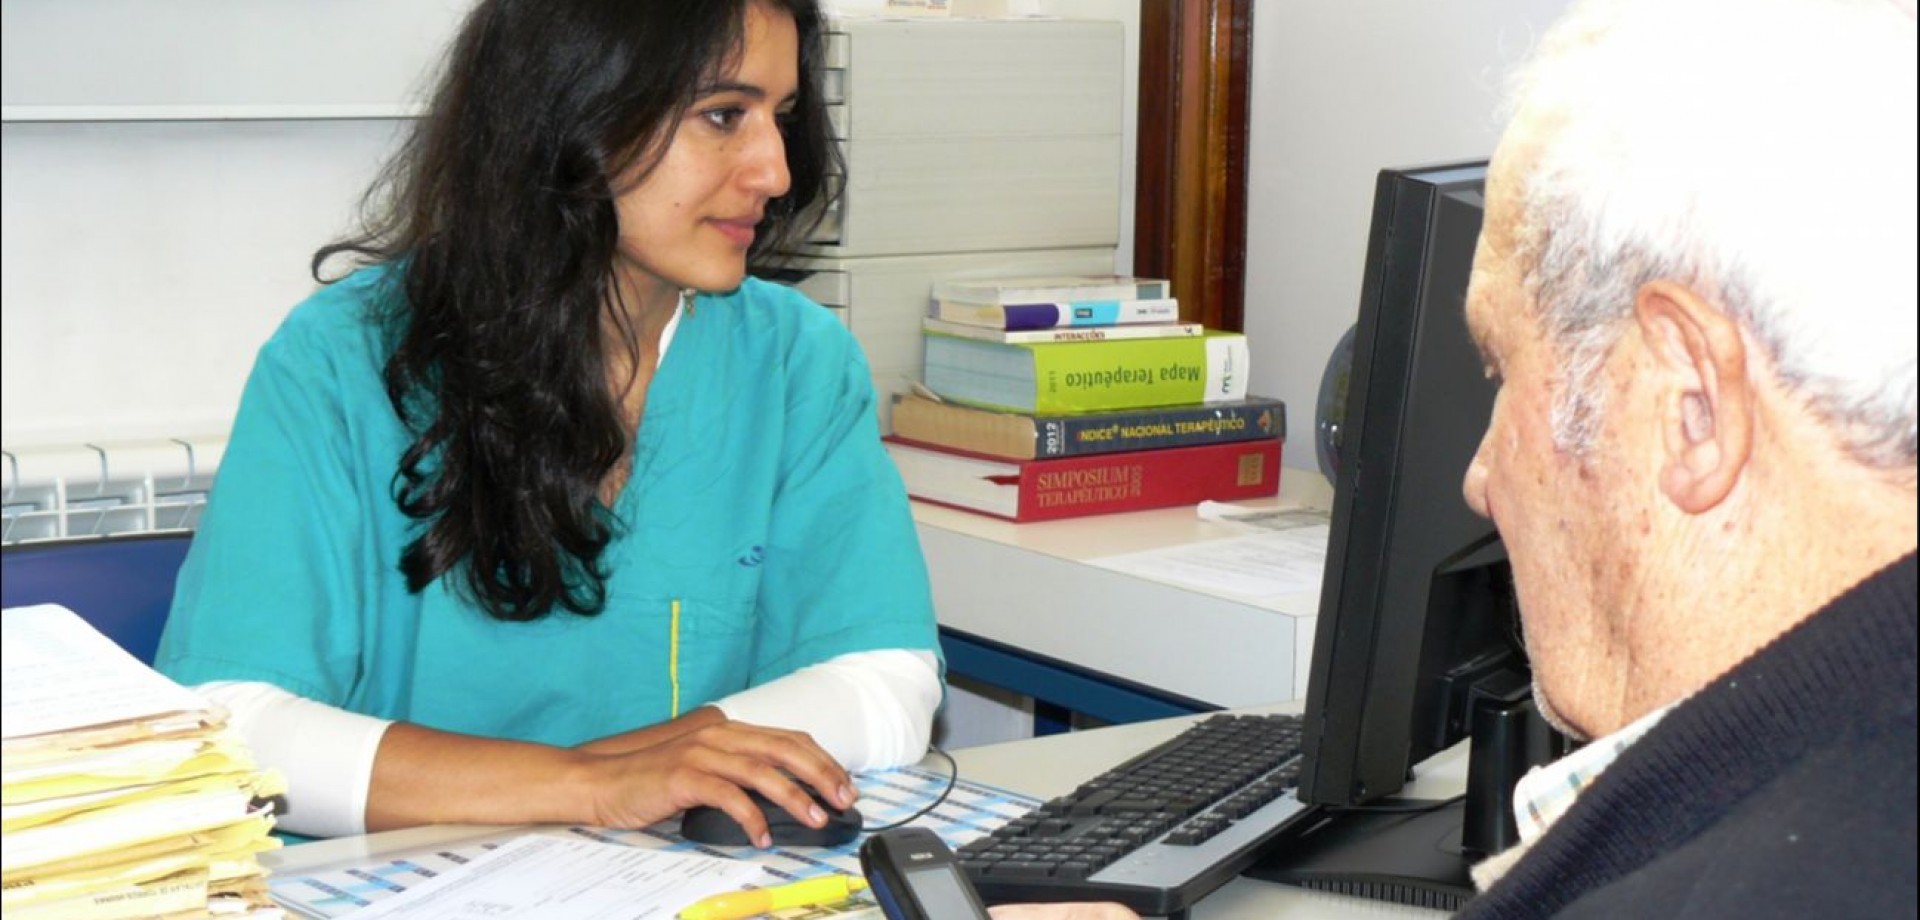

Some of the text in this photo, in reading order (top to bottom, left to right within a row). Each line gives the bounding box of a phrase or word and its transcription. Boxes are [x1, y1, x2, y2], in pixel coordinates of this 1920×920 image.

[1066, 362, 1200, 389] Mapa Terapêutico
[1046, 422, 1057, 454] 2012
[1121, 424, 1173, 438] NACIONAL
[1037, 465, 1129, 490] SIMPOSIUM
